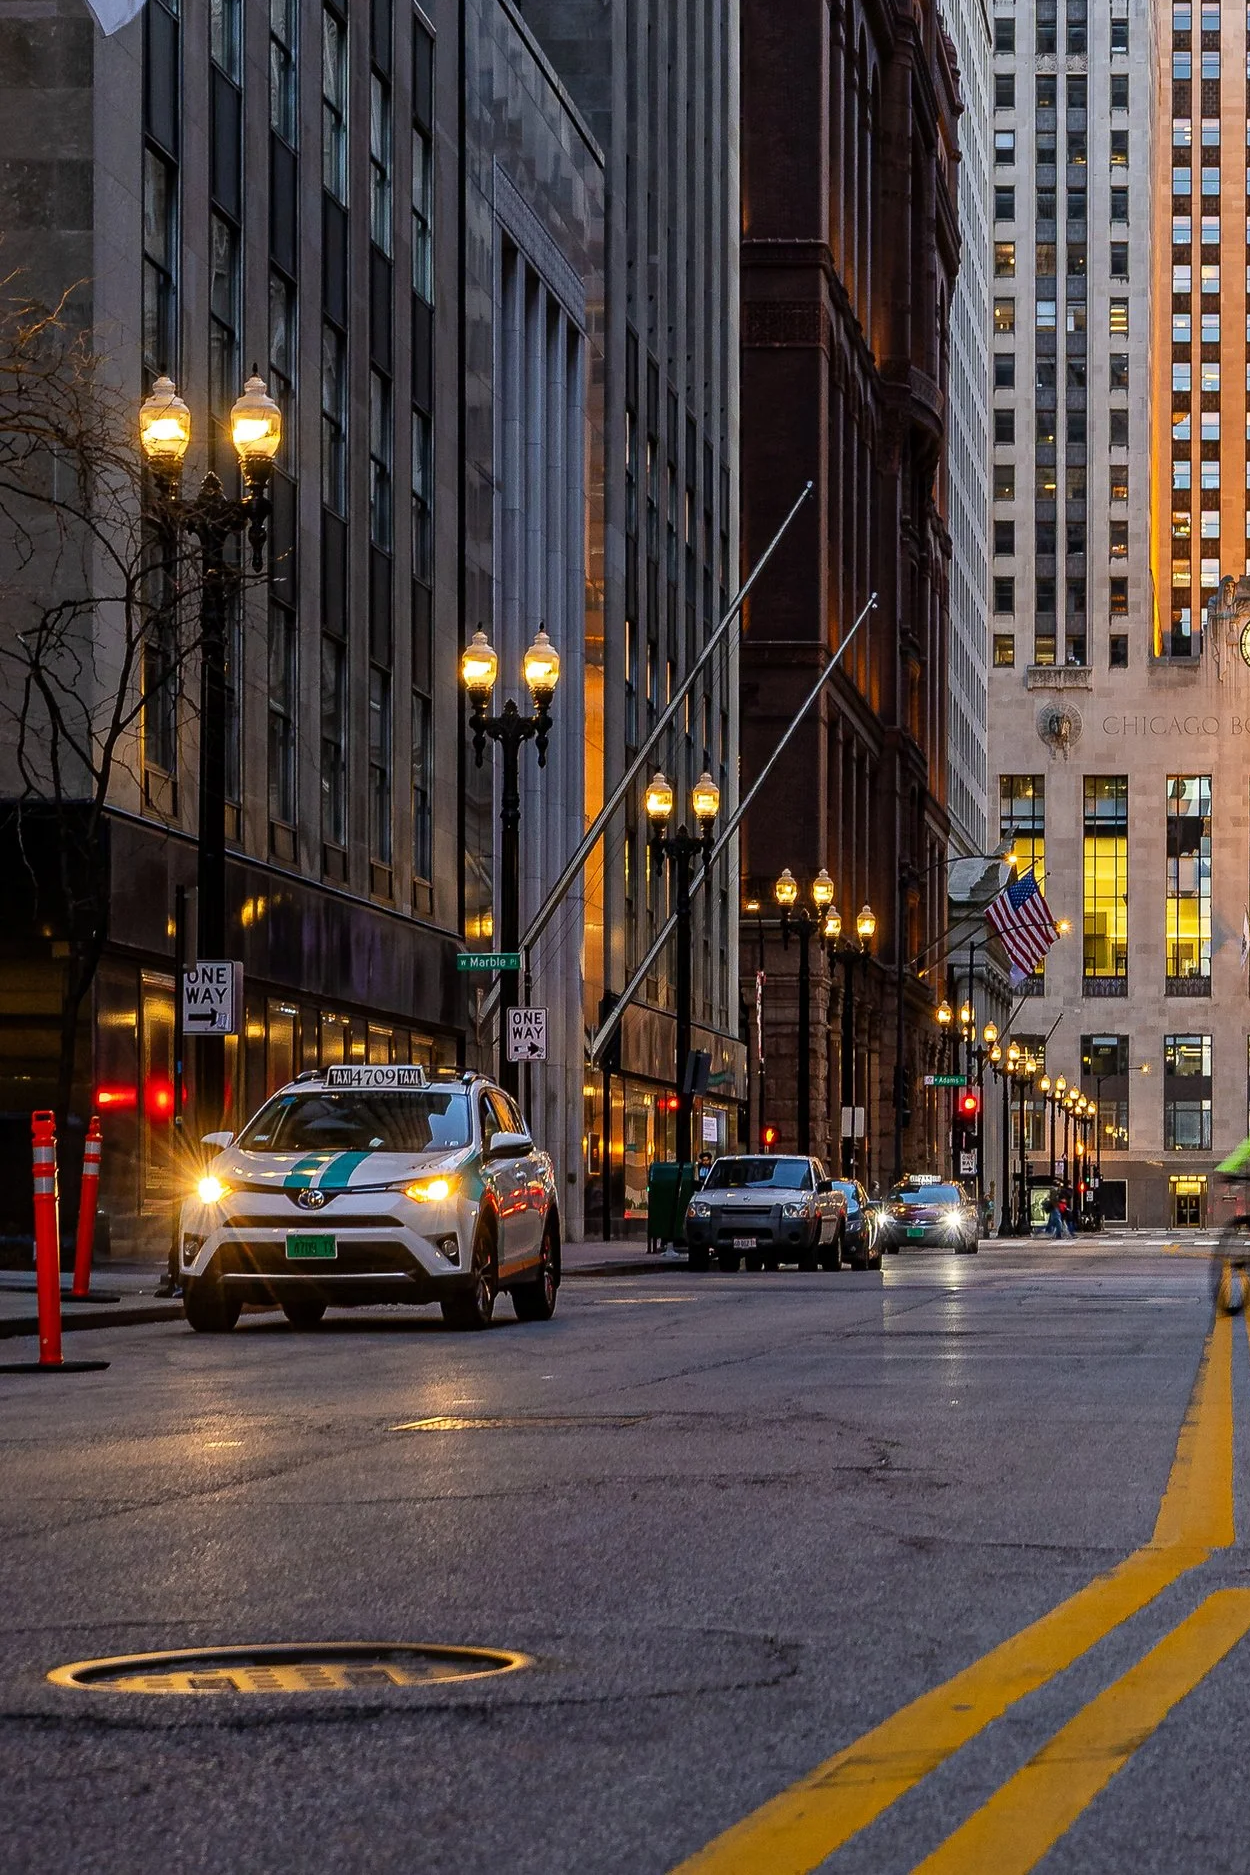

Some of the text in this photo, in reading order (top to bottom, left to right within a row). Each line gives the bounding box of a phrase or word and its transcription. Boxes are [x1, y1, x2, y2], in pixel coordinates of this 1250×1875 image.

[1102, 716, 1220, 736] CHICAGO
[470, 957, 506, 967] Marble
[187, 968, 227, 984] ONE
[186, 988, 228, 1004] WAY
[513, 1012, 543, 1025] ONE
[512, 1027, 543, 1039] WAY
[332, 1069, 418, 1085] TAXI 4709 TAXI
